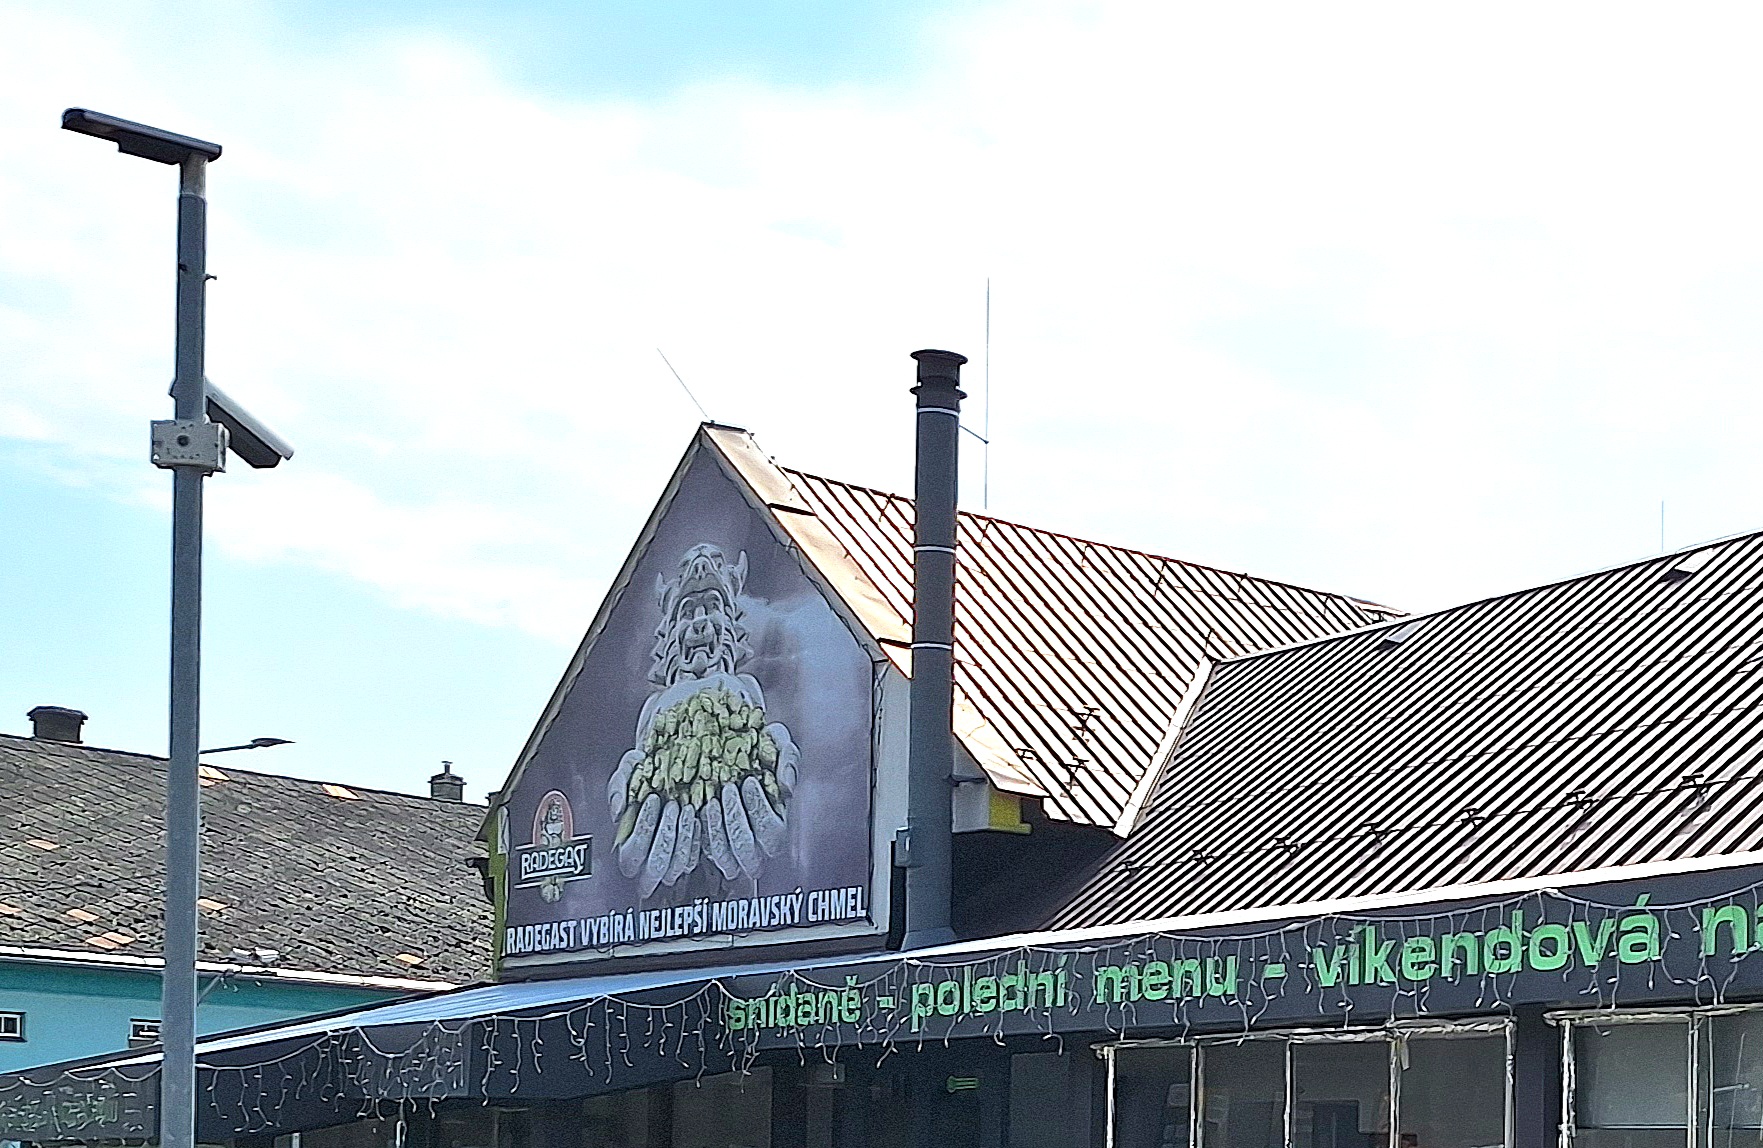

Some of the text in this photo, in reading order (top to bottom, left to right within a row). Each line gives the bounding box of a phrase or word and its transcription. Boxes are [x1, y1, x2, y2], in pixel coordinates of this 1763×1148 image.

[521, 843, 588, 880] RADEGAST
[506, 886, 867, 955] RADEGAST VYBÍRÁ NEJLEPŠÍ MORAVSKÝ CHMEL
[729, 974, 861, 1030] snídaně
[911, 953, 1067, 1032] polední
[1097, 955, 1237, 1004] menu
[1313, 892, 1662, 987] víkendová
